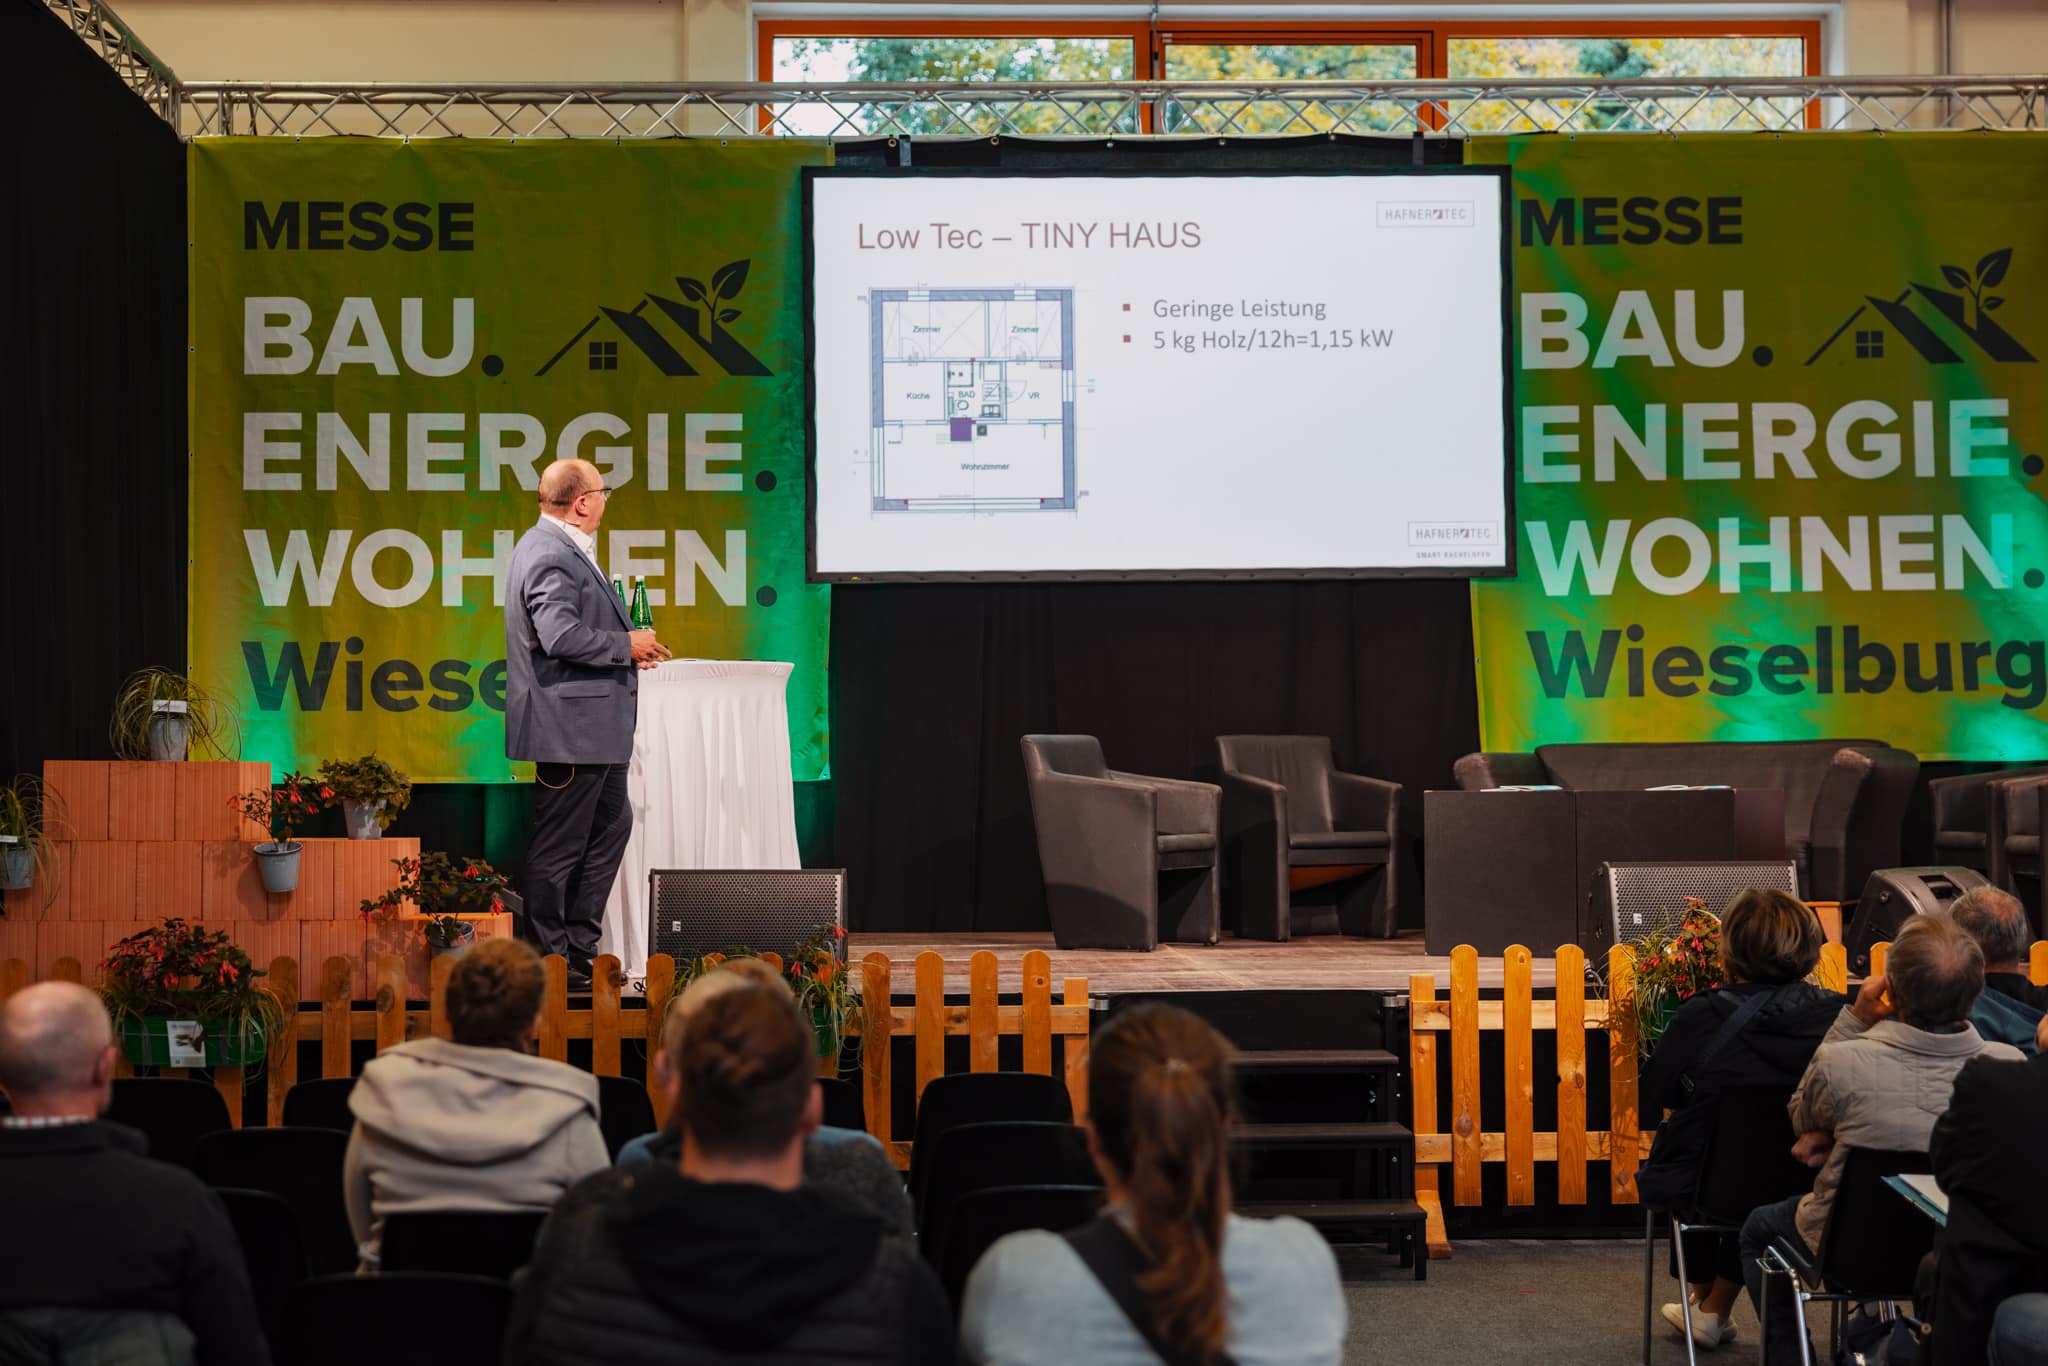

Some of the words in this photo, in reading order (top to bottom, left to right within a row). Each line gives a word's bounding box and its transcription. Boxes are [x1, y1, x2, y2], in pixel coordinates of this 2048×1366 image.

[243, 200, 475, 251] MESSE
[1384, 207, 1432, 220] HAFNER
[1444, 207, 1467, 220] TEC
[1519, 196, 1743, 247] MESSE
[858, 222, 921, 250] Low
[929, 222, 983, 249] Tec
[1020, 221, 1099, 249] TINY
[1108, 221, 1201, 249] HAUS
[912, 325, 942, 333] Zimmer
[1010, 325, 1040, 333] Zimmer
[1153, 299, 1234, 321] Geringe
[1241, 299, 1326, 321] Leistung
[1520, 289, 1774, 370] BAU.
[243, 296, 505, 377] BAU.
[1153, 330, 1166, 349] 5
[1173, 330, 1195, 353] kg
[1202, 328, 1353, 352] Holz/12h=1,15
[1360, 328, 1394, 348] kW
[958, 390, 976, 398] BAD
[242, 411, 778, 492] ENERGIE.
[1522, 398, 2045, 484] ENERGIE.
[960, 463, 1010, 471] Wohnzimmer
[1415, 527, 1460, 539] HAFNER
[1471, 527, 1491, 538] TEC
[243, 528, 778, 608] WOHEN.
[1525, 513, 2046, 597] WOHNEN.
[1526, 623, 2047, 710] Wieselburg
